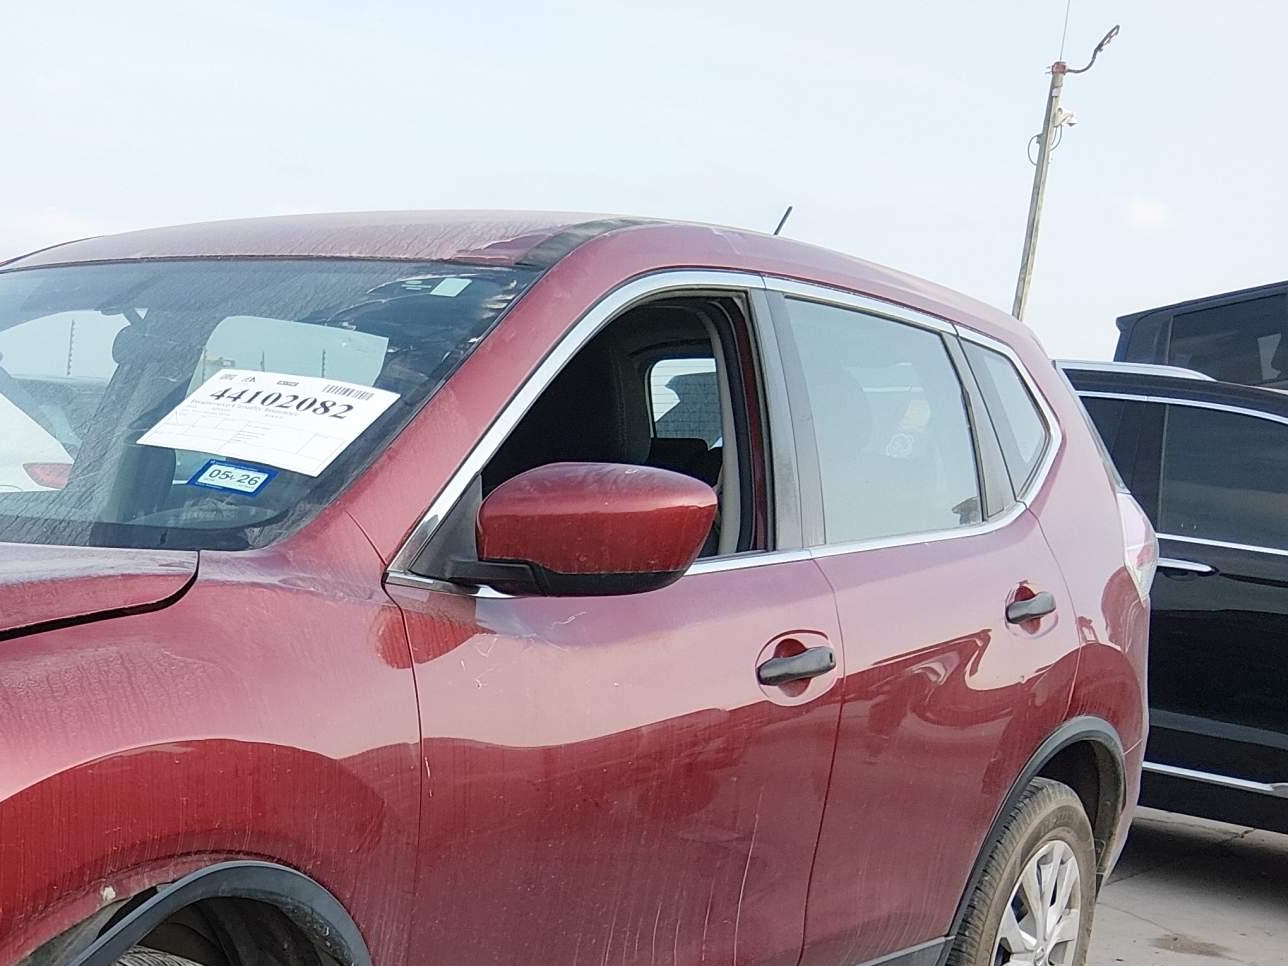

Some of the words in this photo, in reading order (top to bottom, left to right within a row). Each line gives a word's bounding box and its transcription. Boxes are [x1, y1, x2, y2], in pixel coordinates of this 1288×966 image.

[210, 387, 354, 419] 44102082
[208, 469, 232, 480] 05
[236, 474, 261, 486] 26
